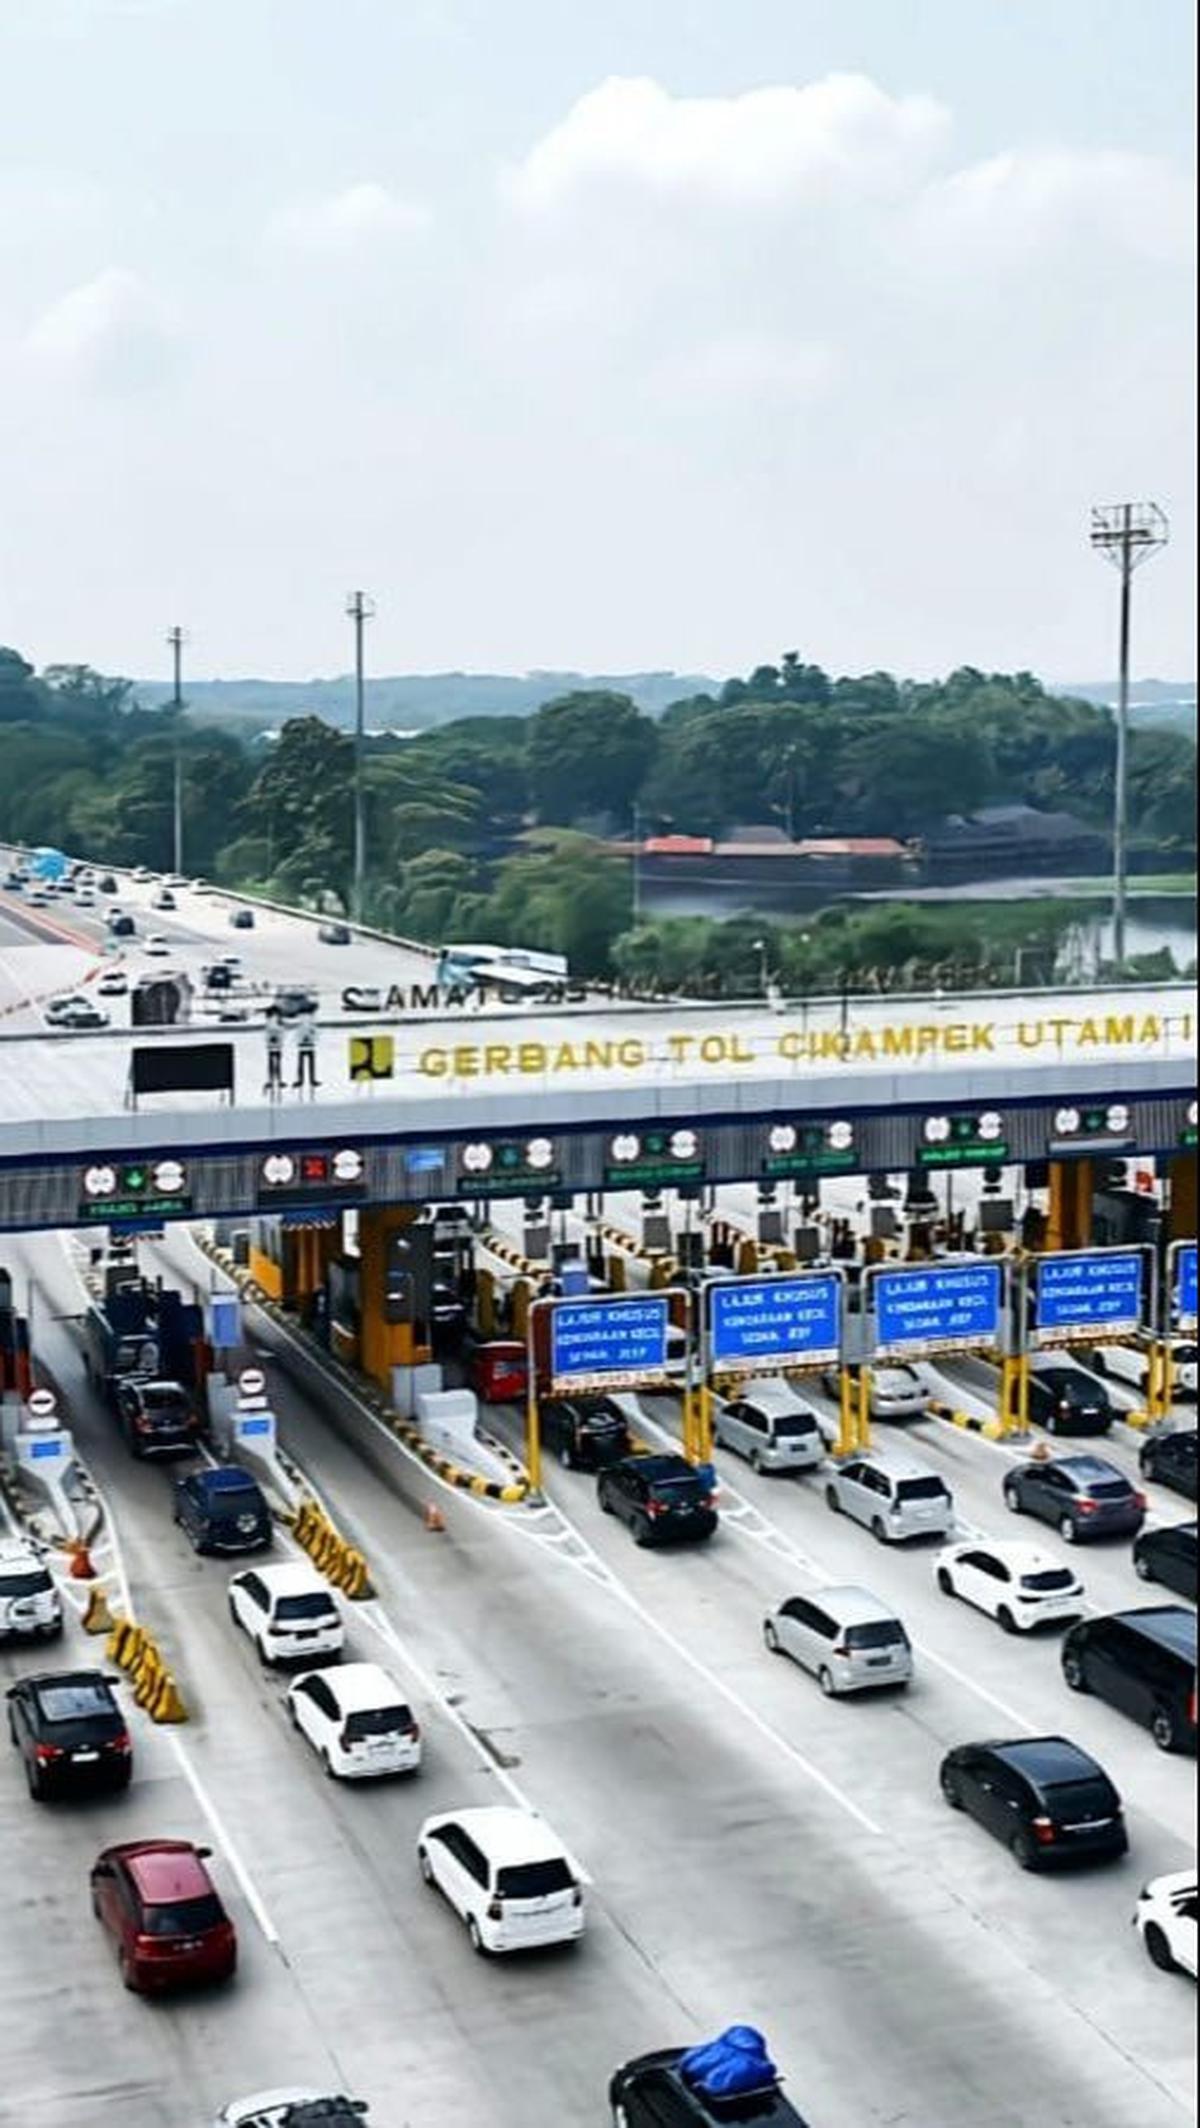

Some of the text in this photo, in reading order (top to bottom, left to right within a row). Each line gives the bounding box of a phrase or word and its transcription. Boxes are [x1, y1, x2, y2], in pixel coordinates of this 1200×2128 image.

[419, 1039, 645, 1077] GERBANG
[667, 1034, 755, 1063] TOL
[778, 1022, 996, 1060] CIKAMPEK
[1017, 1014, 1161, 1048] UTAMA
